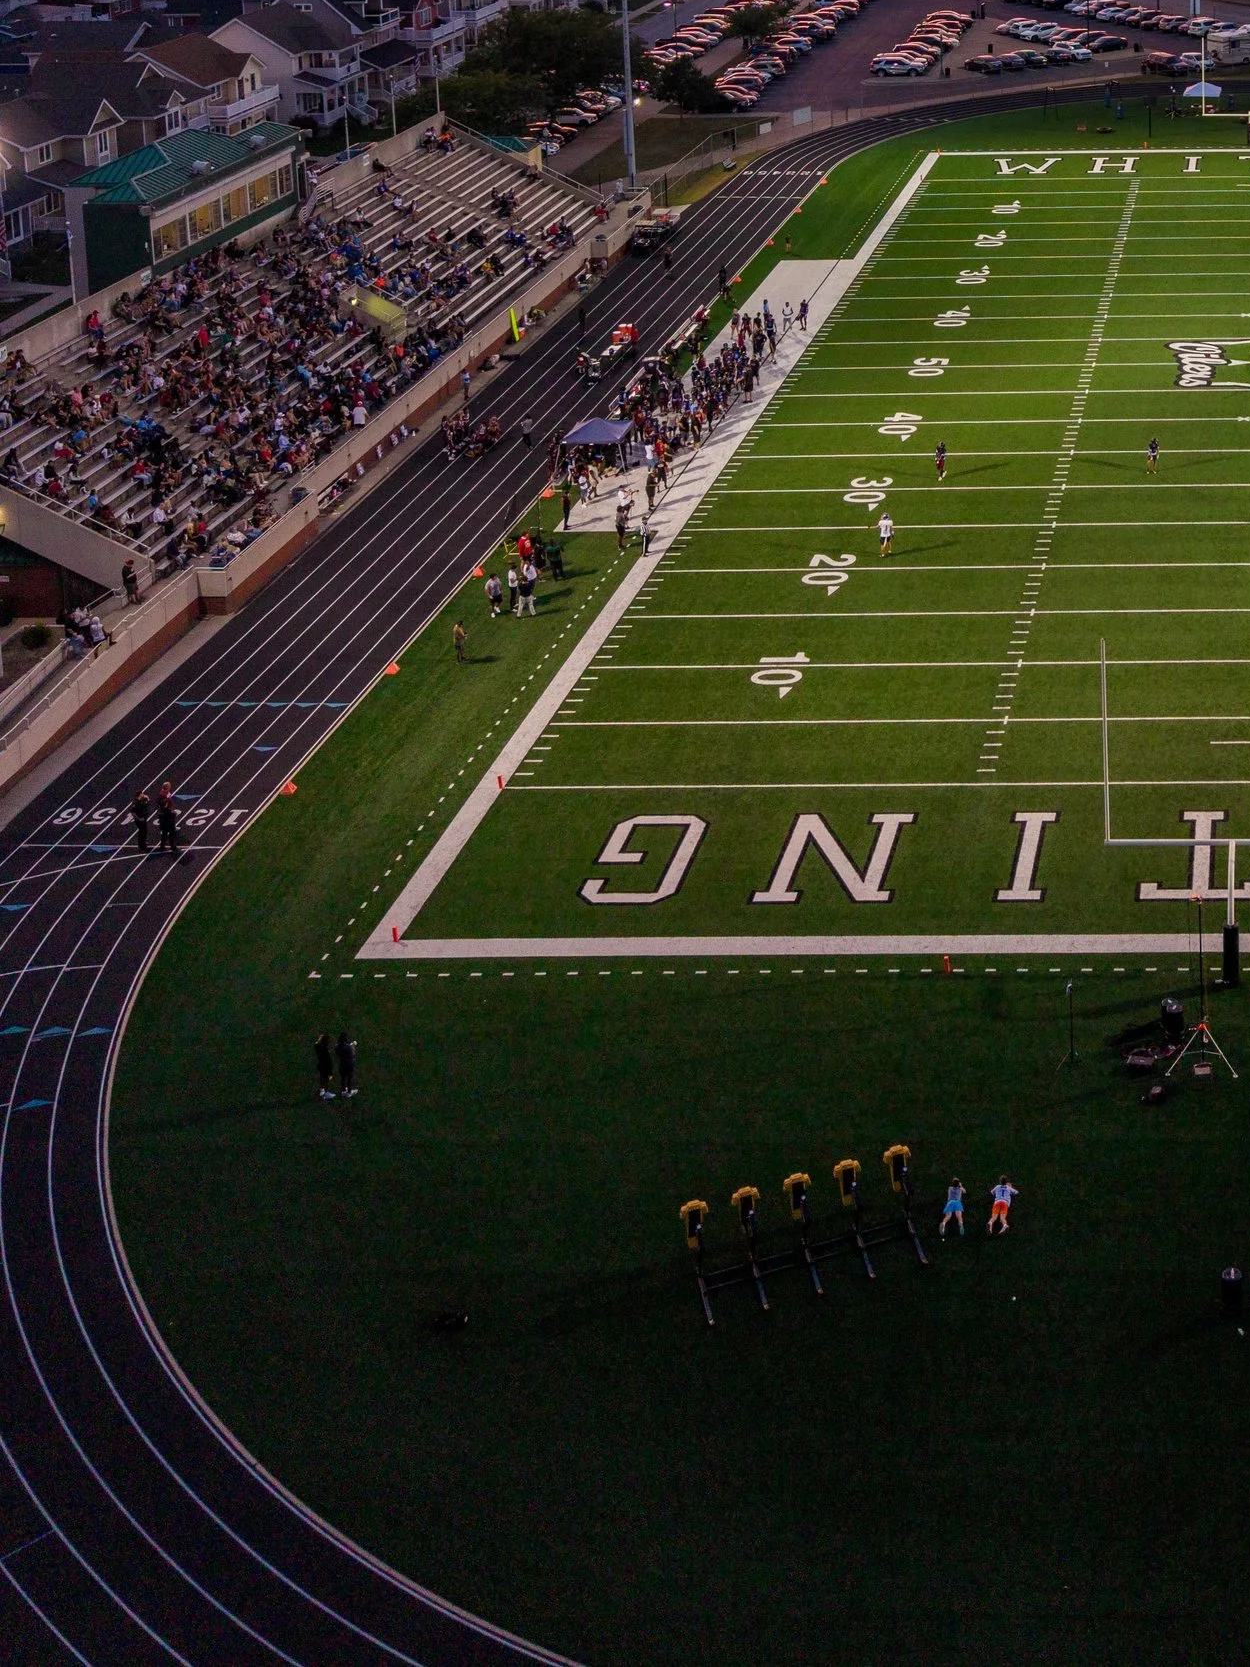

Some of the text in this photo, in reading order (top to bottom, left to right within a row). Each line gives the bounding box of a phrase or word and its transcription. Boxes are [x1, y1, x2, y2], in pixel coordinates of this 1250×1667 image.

[991, 203, 1021, 214] 10
[974, 234, 1007, 247] 20
[955, 269, 991, 284] 30
[933, 310, 971, 327] 40
[907, 357, 950, 377] 50
[1166, 341, 1230, 388] Oilers
[877, 412, 923, 434] 40
[843, 476, 894, 503] 30
[801, 553, 857, 585] 20
[750, 651, 811, 685] 10
[53, 807, 83, 825] 6
[85, 807, 117, 825] 5
[185, 808, 215, 826] 2
[222, 808, 249, 827] 1
